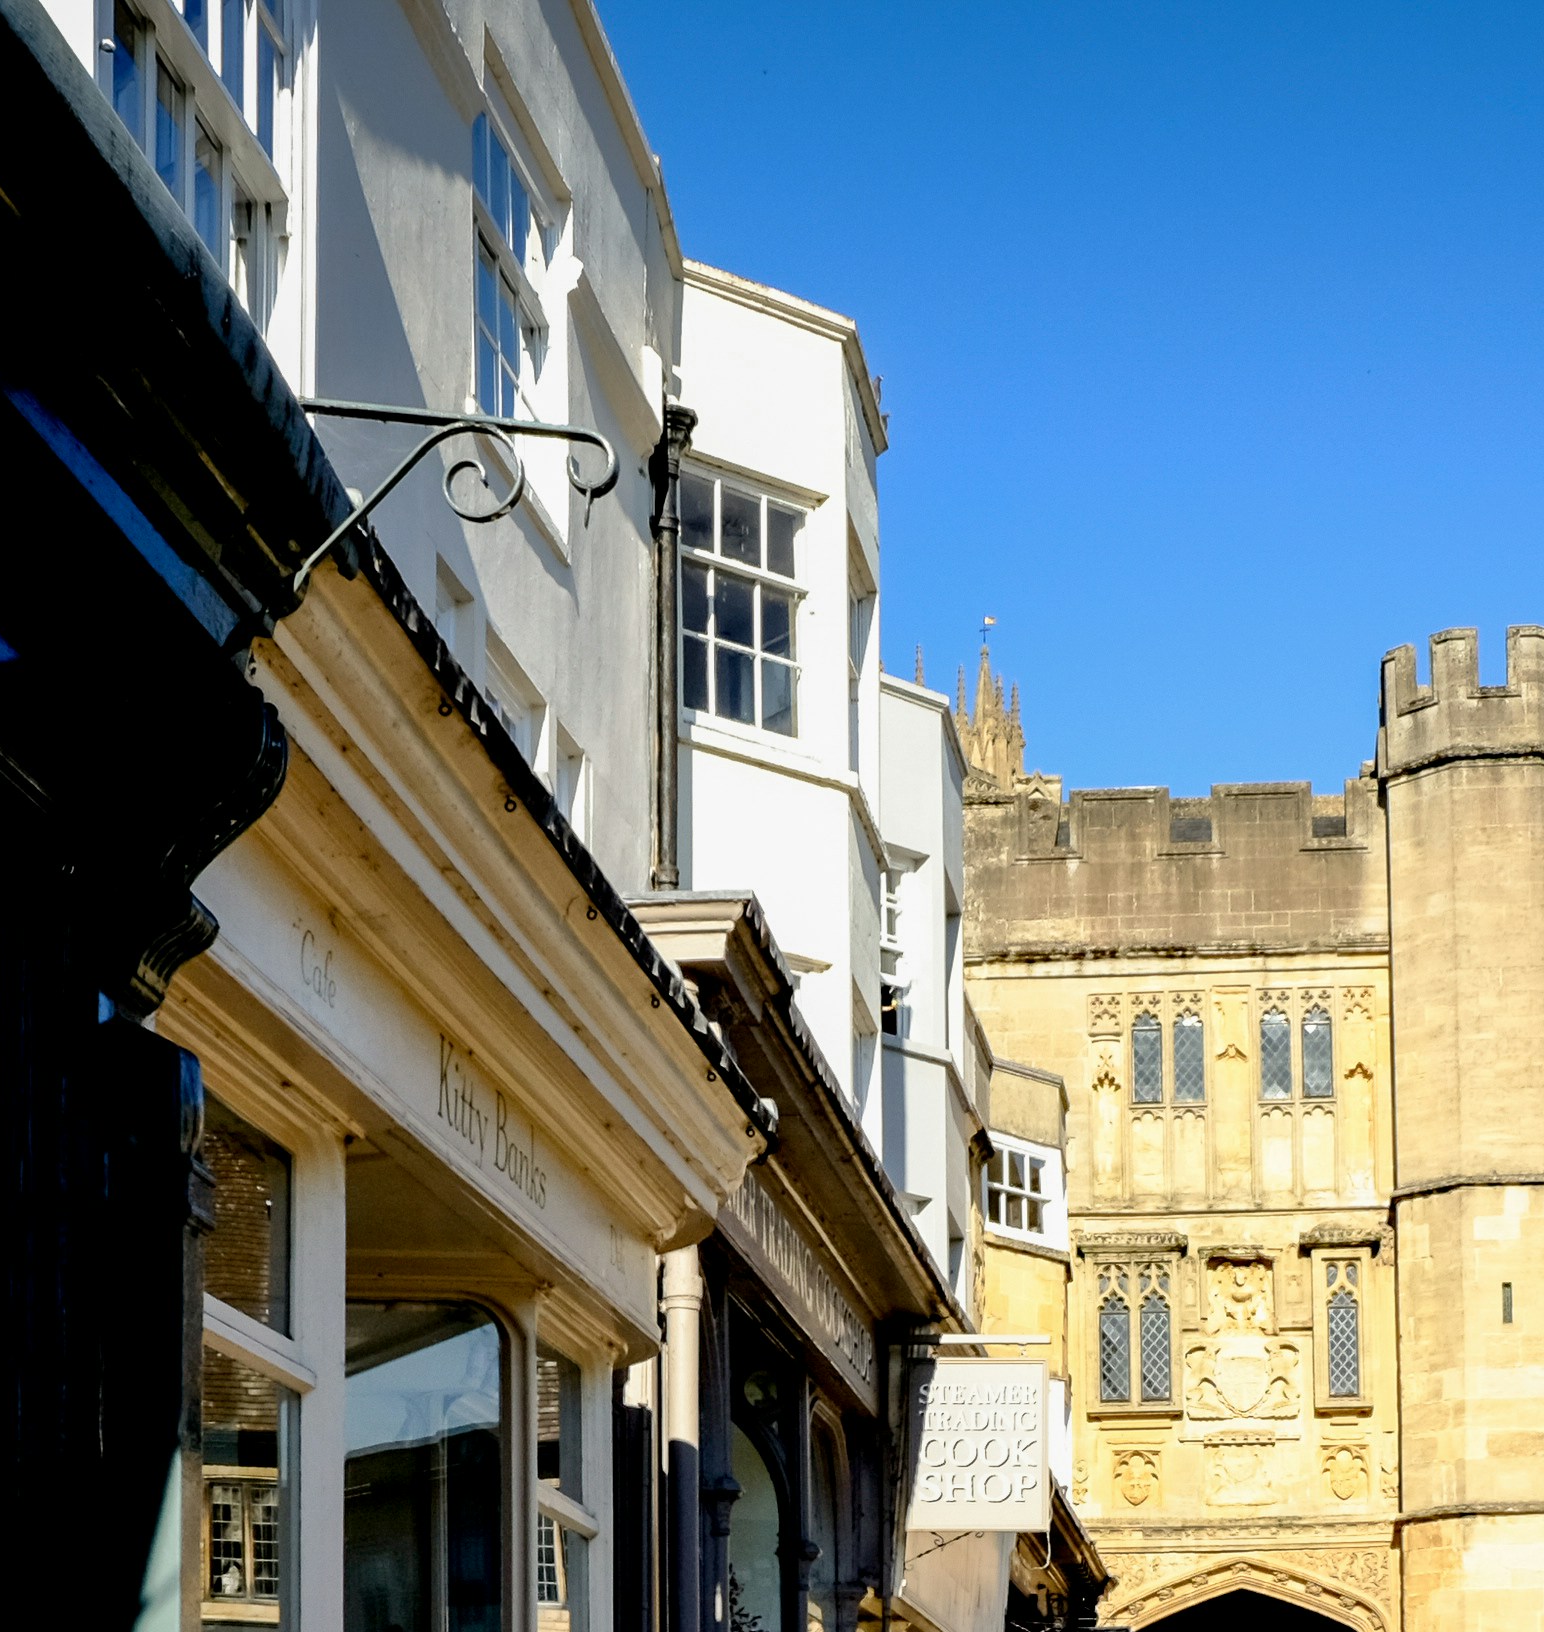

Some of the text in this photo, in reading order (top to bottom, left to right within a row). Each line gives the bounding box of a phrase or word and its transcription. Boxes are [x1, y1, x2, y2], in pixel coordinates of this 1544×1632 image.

[437, 1033, 548, 1210] Kitty Banks
[761, 1186, 814, 1313] TRADING
[918, 1383, 1038, 1405] STEAMER
[918, 1409, 1038, 1432] TRADING
[919, 1438, 1038, 1468] COOK
[919, 1473, 1039, 1504] SHOP
